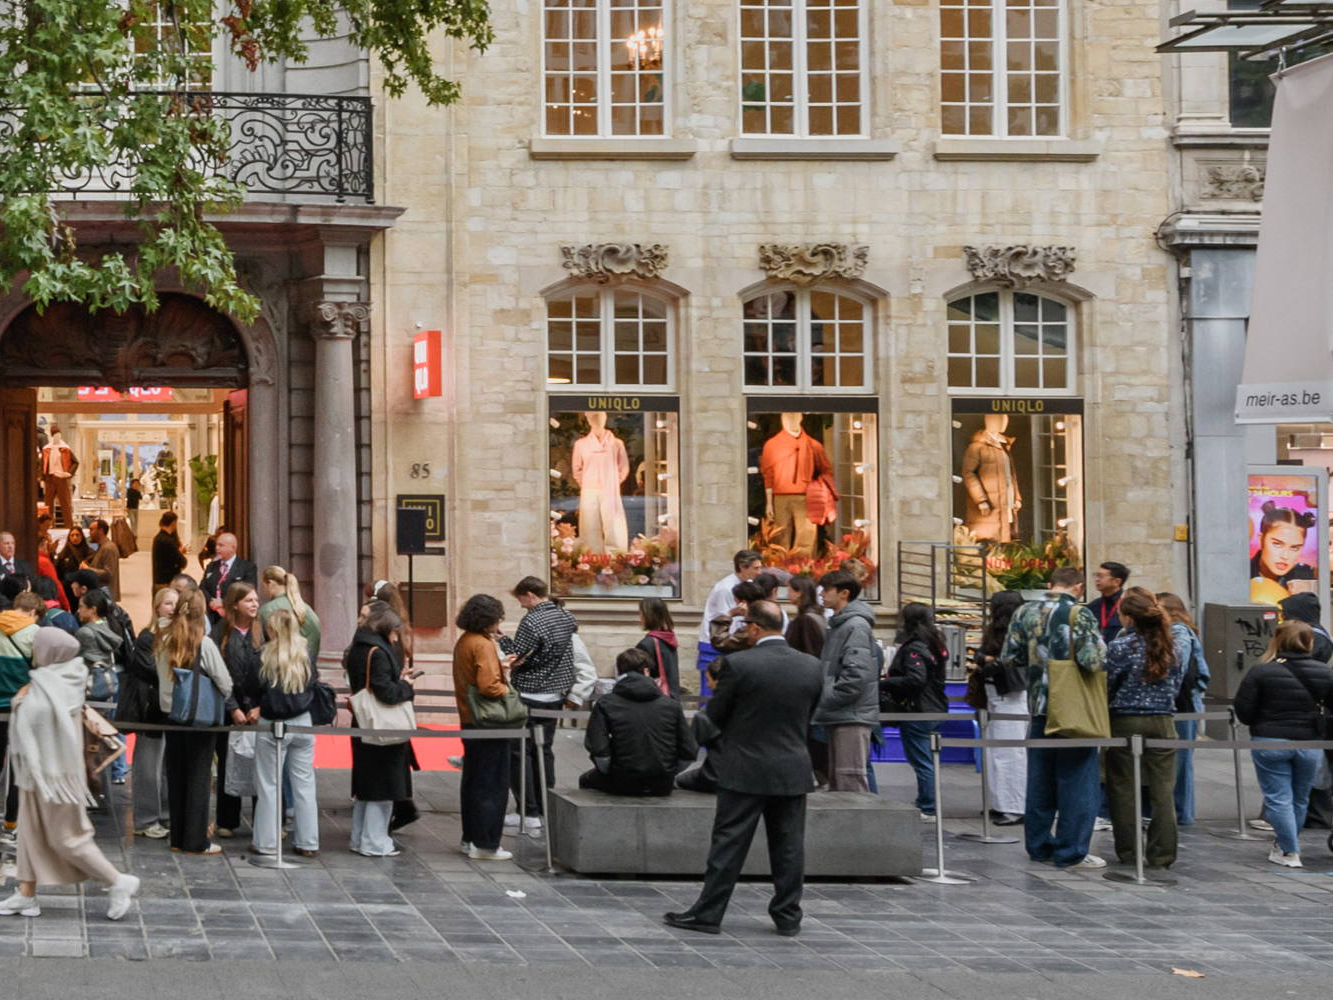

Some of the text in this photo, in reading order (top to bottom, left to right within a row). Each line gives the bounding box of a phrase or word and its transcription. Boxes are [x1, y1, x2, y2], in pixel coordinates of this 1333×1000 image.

[588, 398, 640, 411] UNIQLO
[1246, 390, 1321, 407] meir-as.be
[992, 400, 1044, 413] UNIQLO
[410, 463, 430, 479] 85
